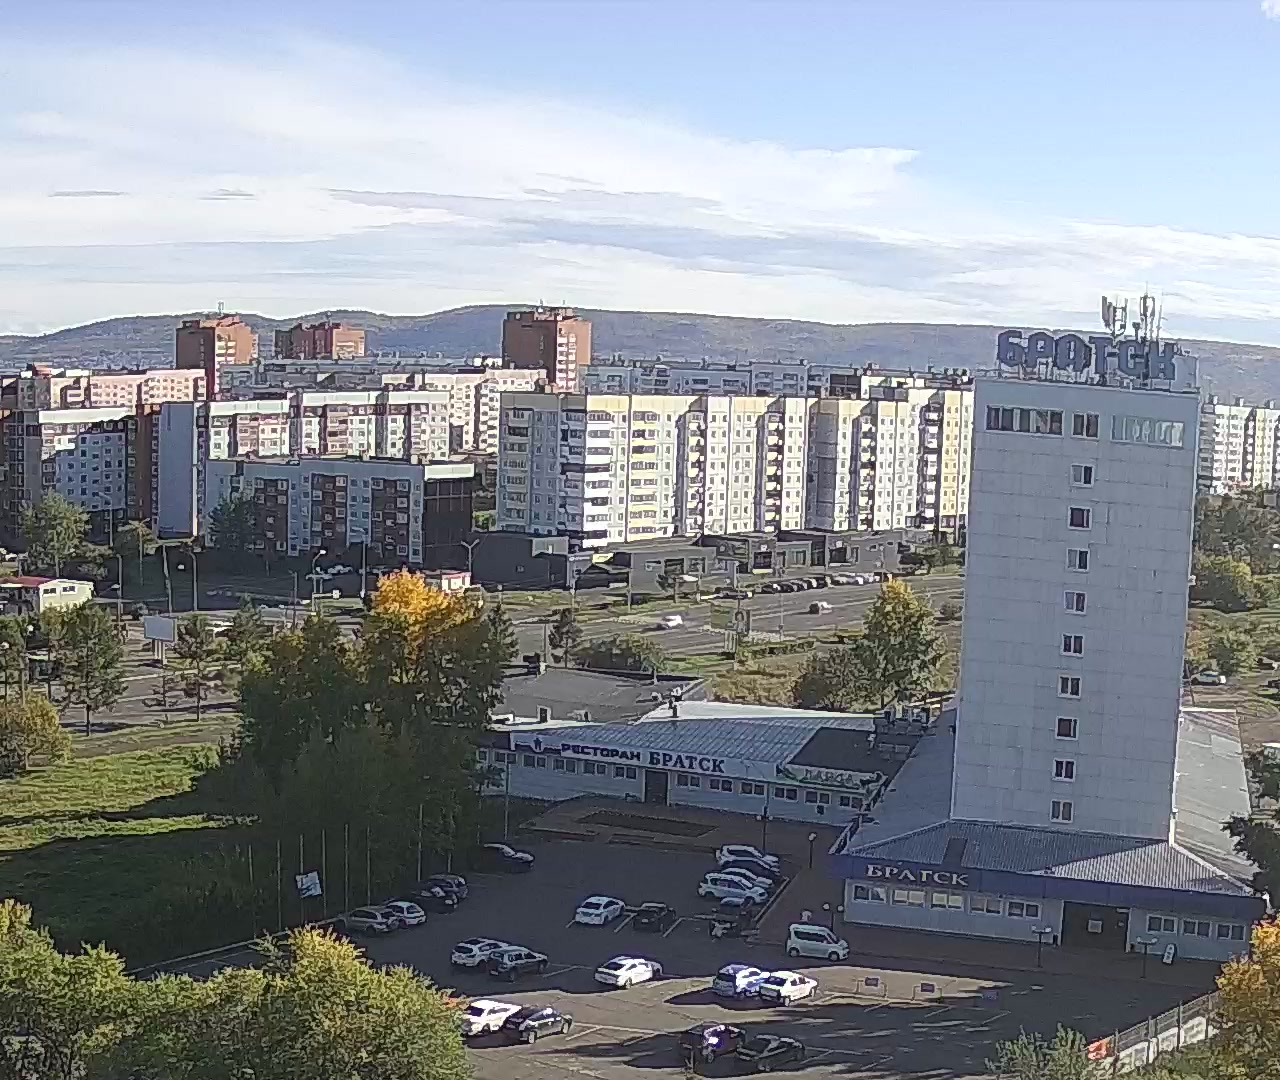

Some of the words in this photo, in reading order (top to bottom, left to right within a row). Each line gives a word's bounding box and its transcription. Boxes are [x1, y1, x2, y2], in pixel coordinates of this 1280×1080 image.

[561, 742, 640, 762] РЕСТОРАН
[648, 751, 725, 774] БРАТСК
[866, 864, 969, 886] БРАТСК
